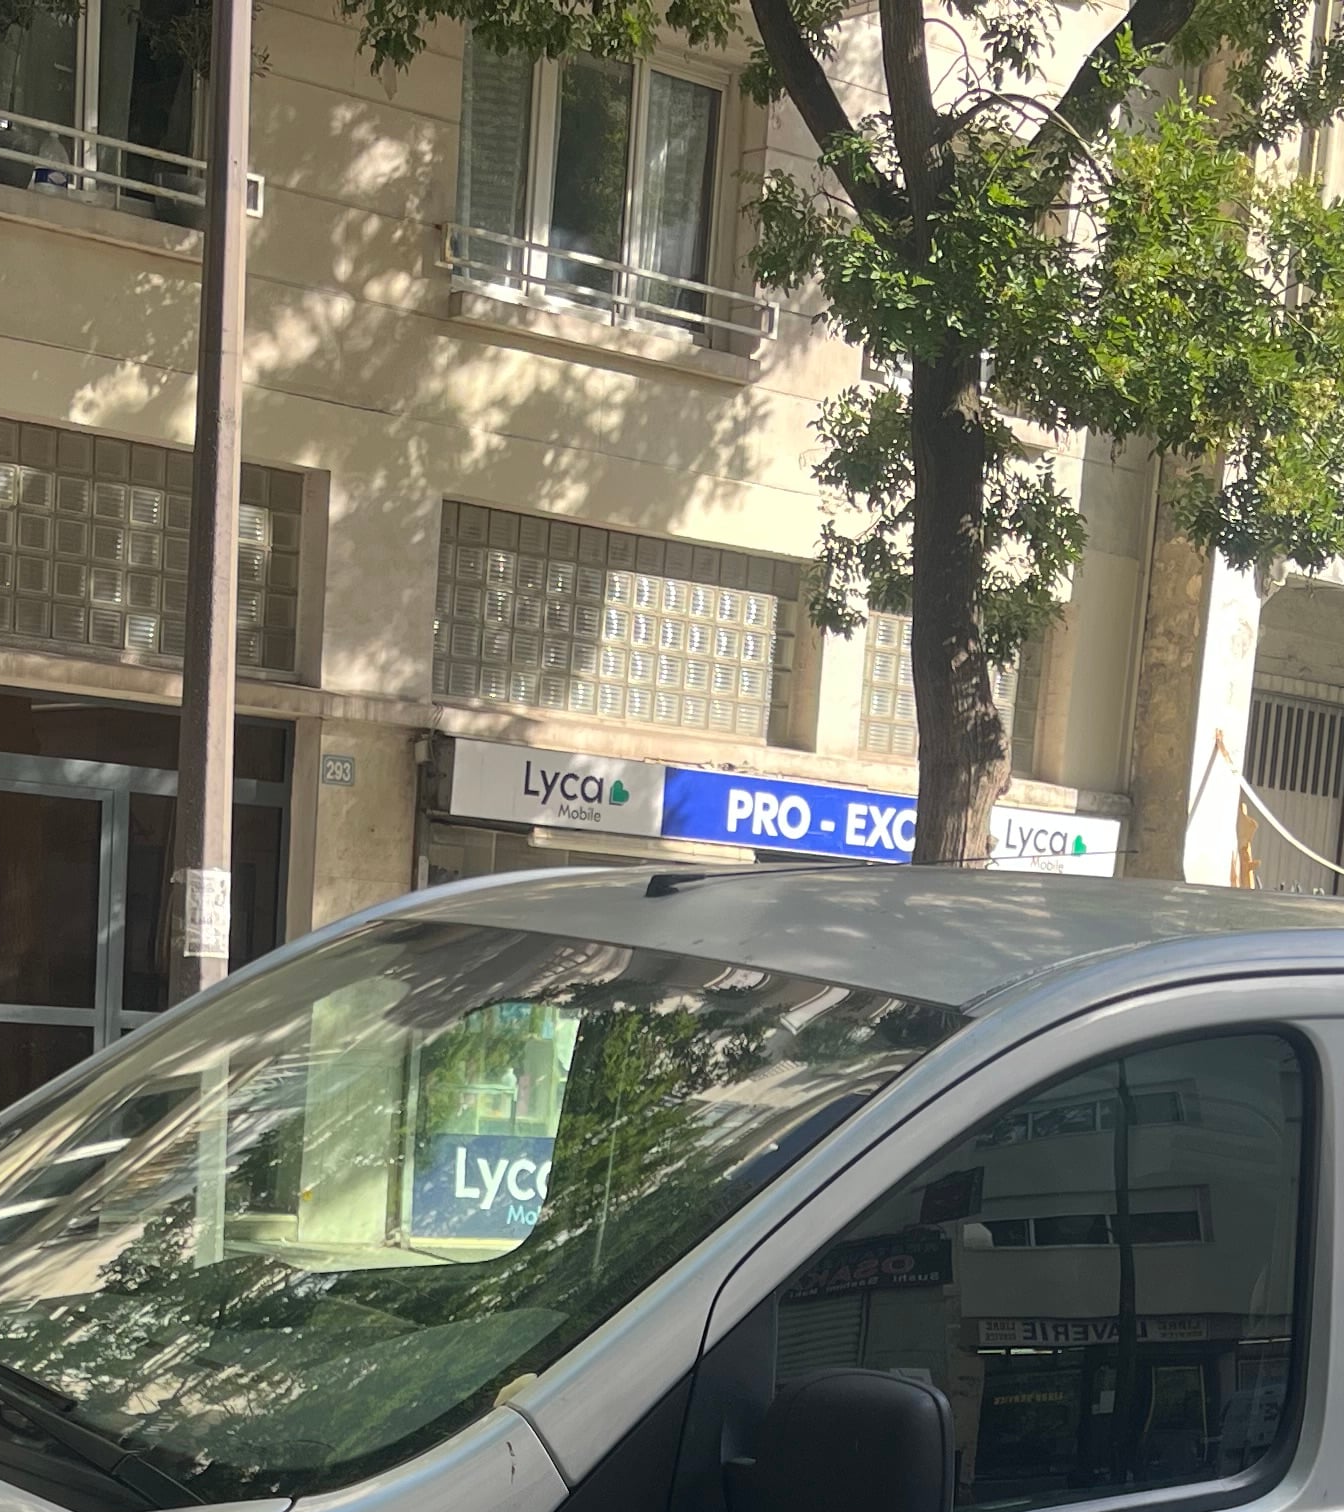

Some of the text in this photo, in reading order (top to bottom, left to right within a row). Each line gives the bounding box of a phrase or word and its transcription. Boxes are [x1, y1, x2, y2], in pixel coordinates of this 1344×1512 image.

[326, 761, 351, 781] 293
[524, 761, 603, 805] Lyca
[558, 804, 601, 822] Mobile
[727, 789, 812, 840] PRO
[1005, 818, 1068, 857] Lyca
[1030, 855, 1064, 873] Mobile
